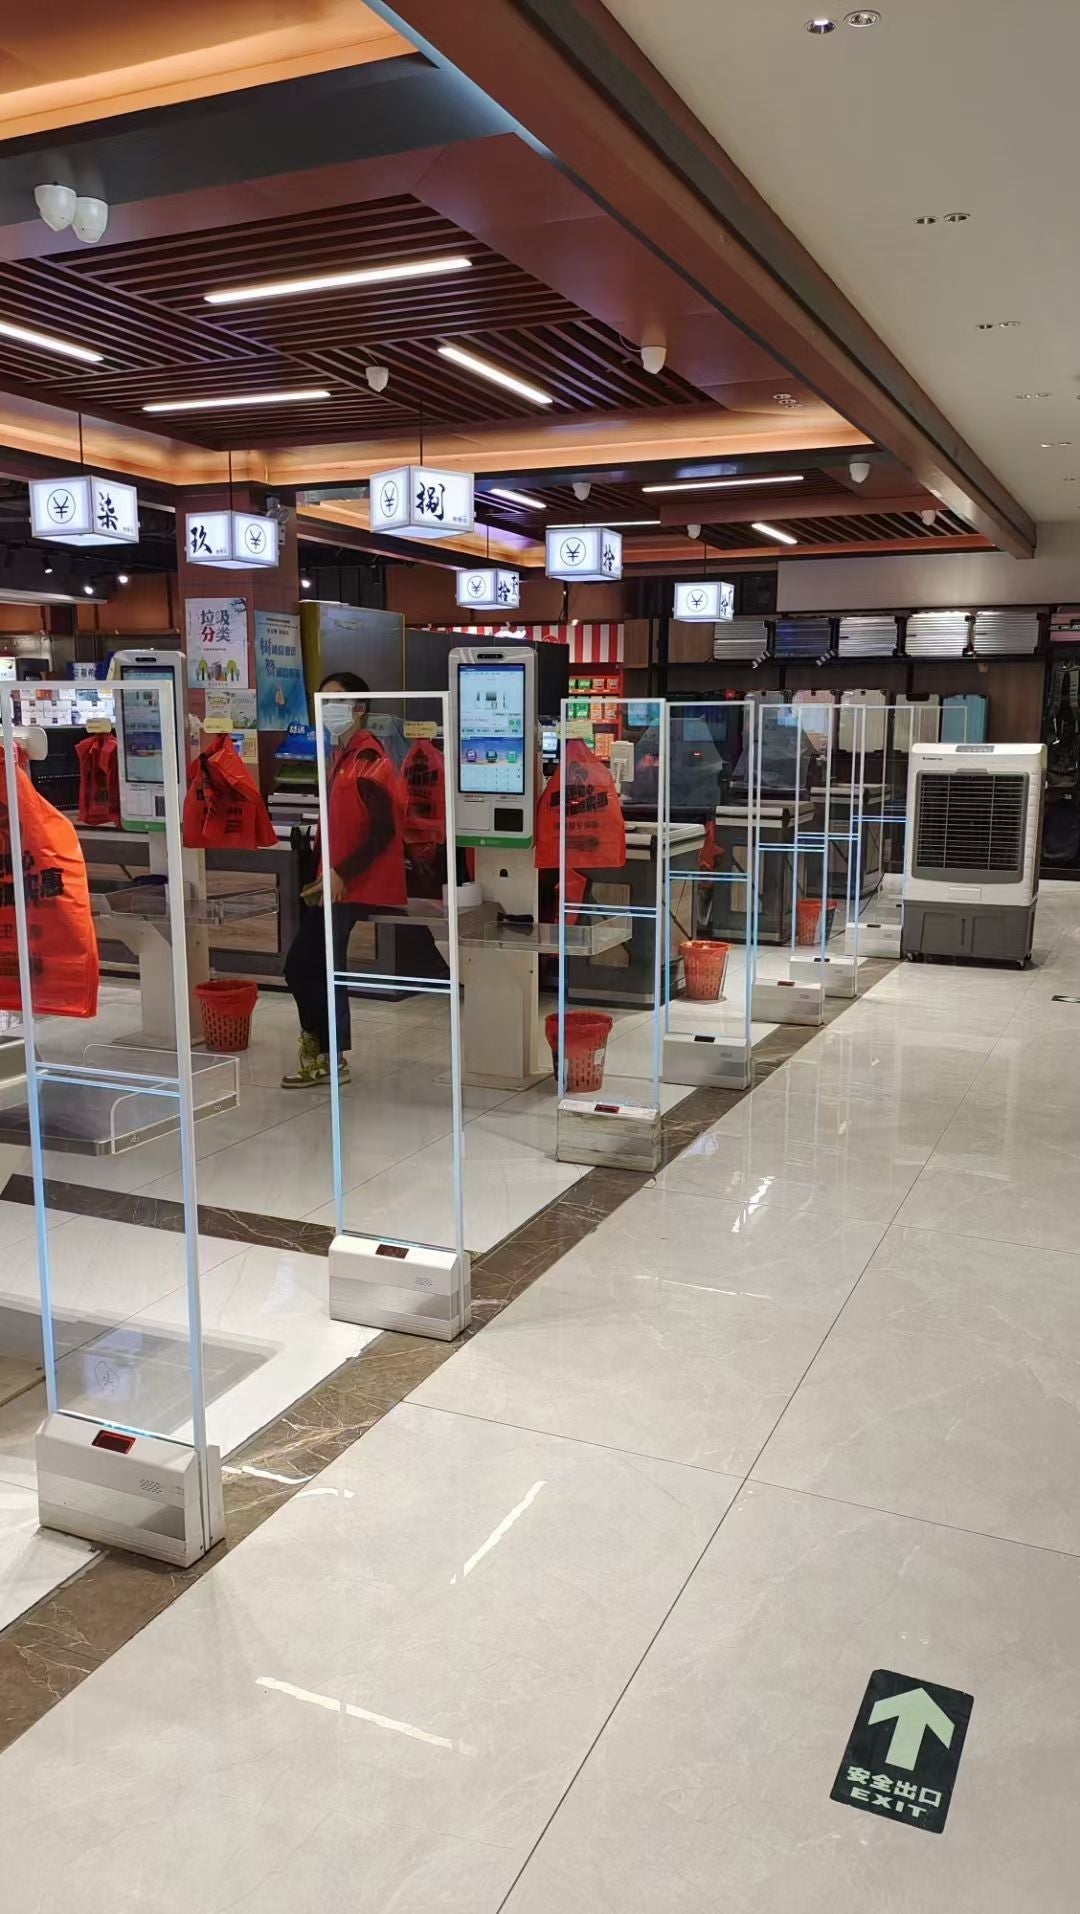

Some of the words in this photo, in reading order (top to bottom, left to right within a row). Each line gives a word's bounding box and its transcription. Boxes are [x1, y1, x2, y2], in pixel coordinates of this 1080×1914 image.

[97, 492, 118, 530] 柒
[190, 525, 212, 554] 玖
[201, 609, 230, 626] 垃圾
[201, 626, 231, 642] 分类
[847, 1766, 942, 1807] 安全出口
[850, 1787, 927, 1818] EXIT
